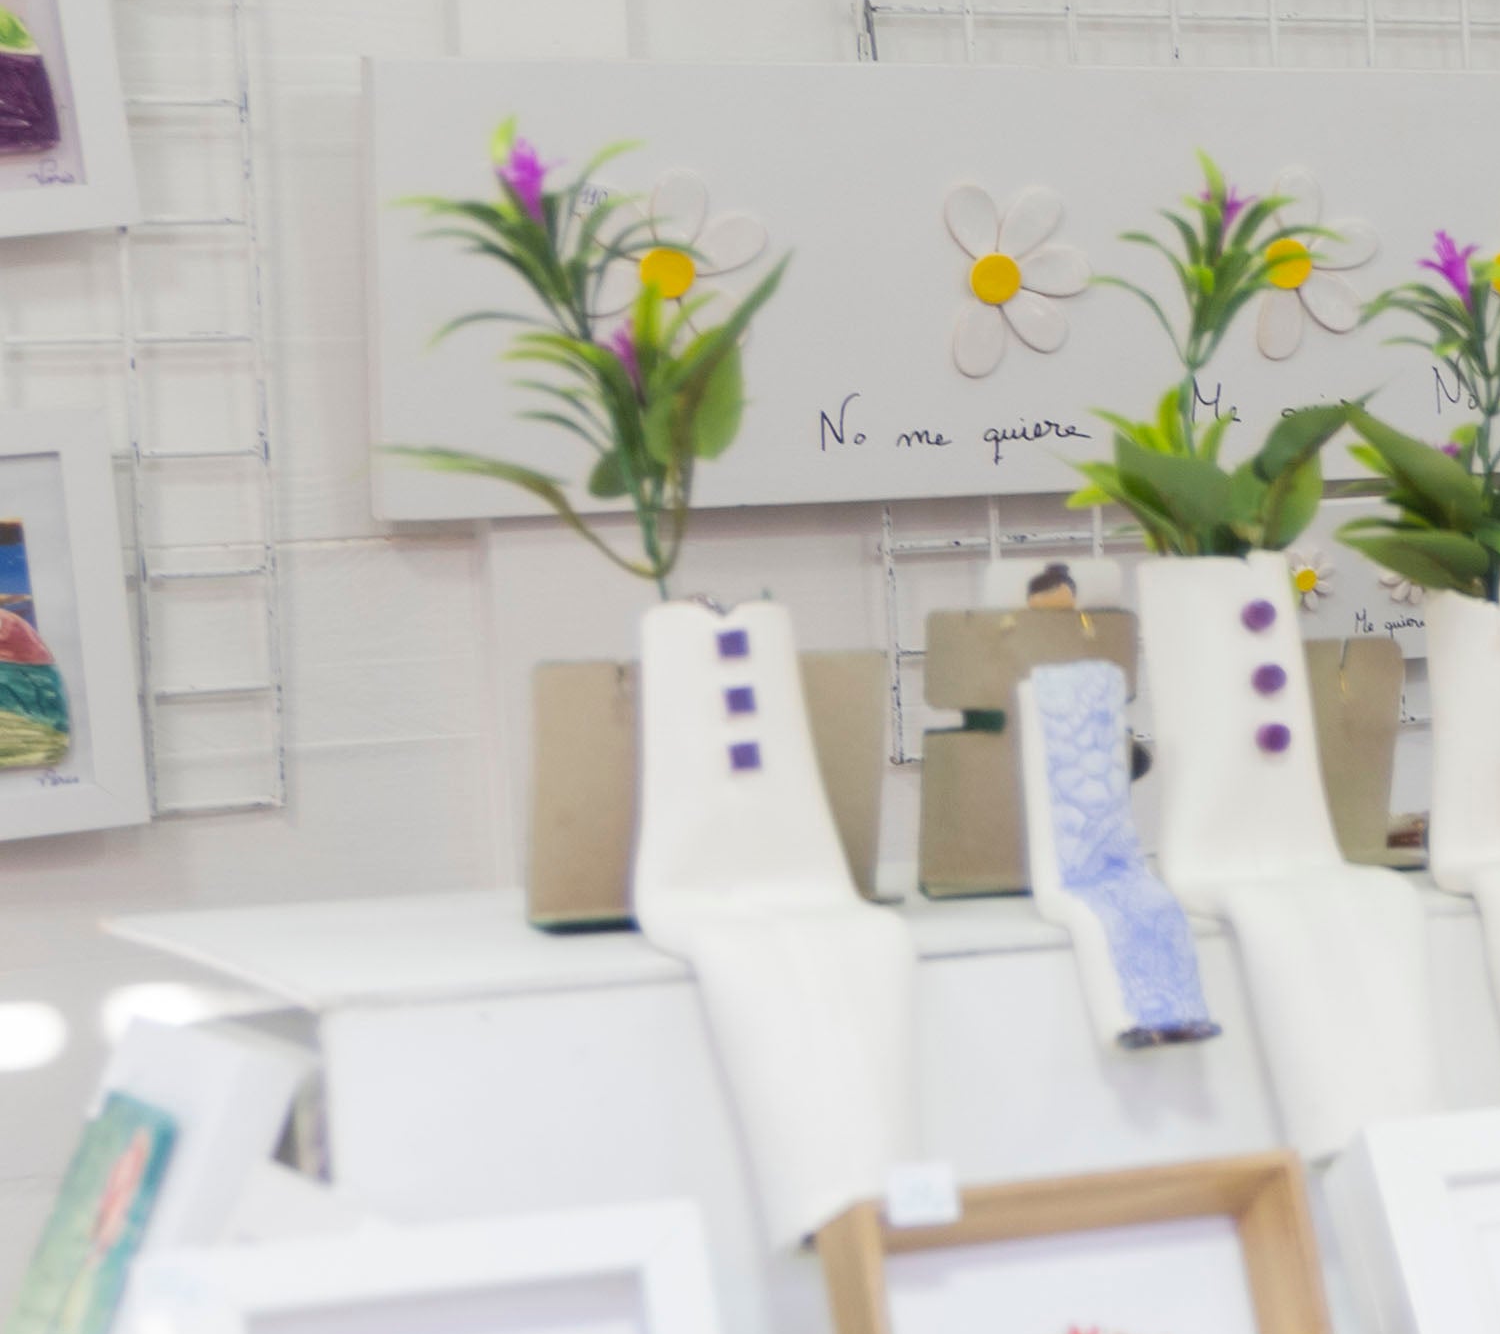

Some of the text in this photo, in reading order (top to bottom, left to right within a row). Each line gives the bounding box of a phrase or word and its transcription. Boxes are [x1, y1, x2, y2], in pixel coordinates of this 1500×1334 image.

[819, 393, 866, 451] No
[896, 430, 952, 447] me
[983, 417, 1093, 466] quiere
[1191, 377, 1242, 424] Me
[1432, 355, 1478, 414] No
[1355, 608, 1374, 634] Me
[1385, 613, 1425, 638] quiere
